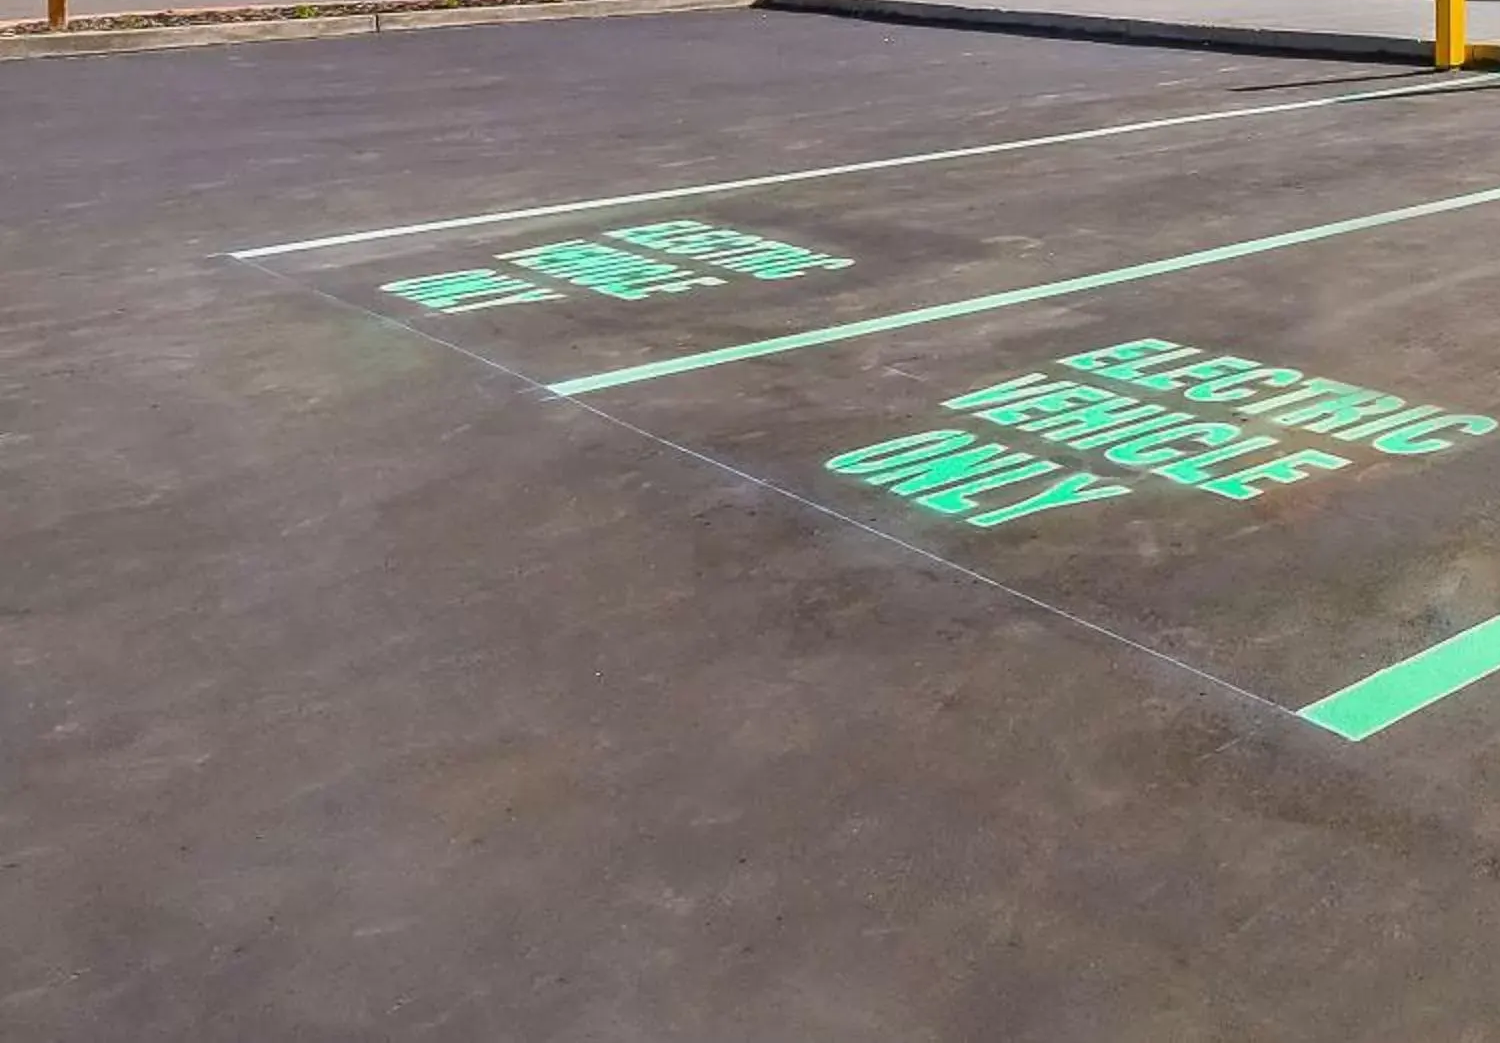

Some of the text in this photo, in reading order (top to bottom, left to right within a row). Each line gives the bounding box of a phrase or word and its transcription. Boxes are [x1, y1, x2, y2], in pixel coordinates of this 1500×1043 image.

[939, 373, 1352, 500] VEHICLE
[1056, 338, 1499, 454] ELECTRIC
[825, 430, 1133, 527] ONLY
